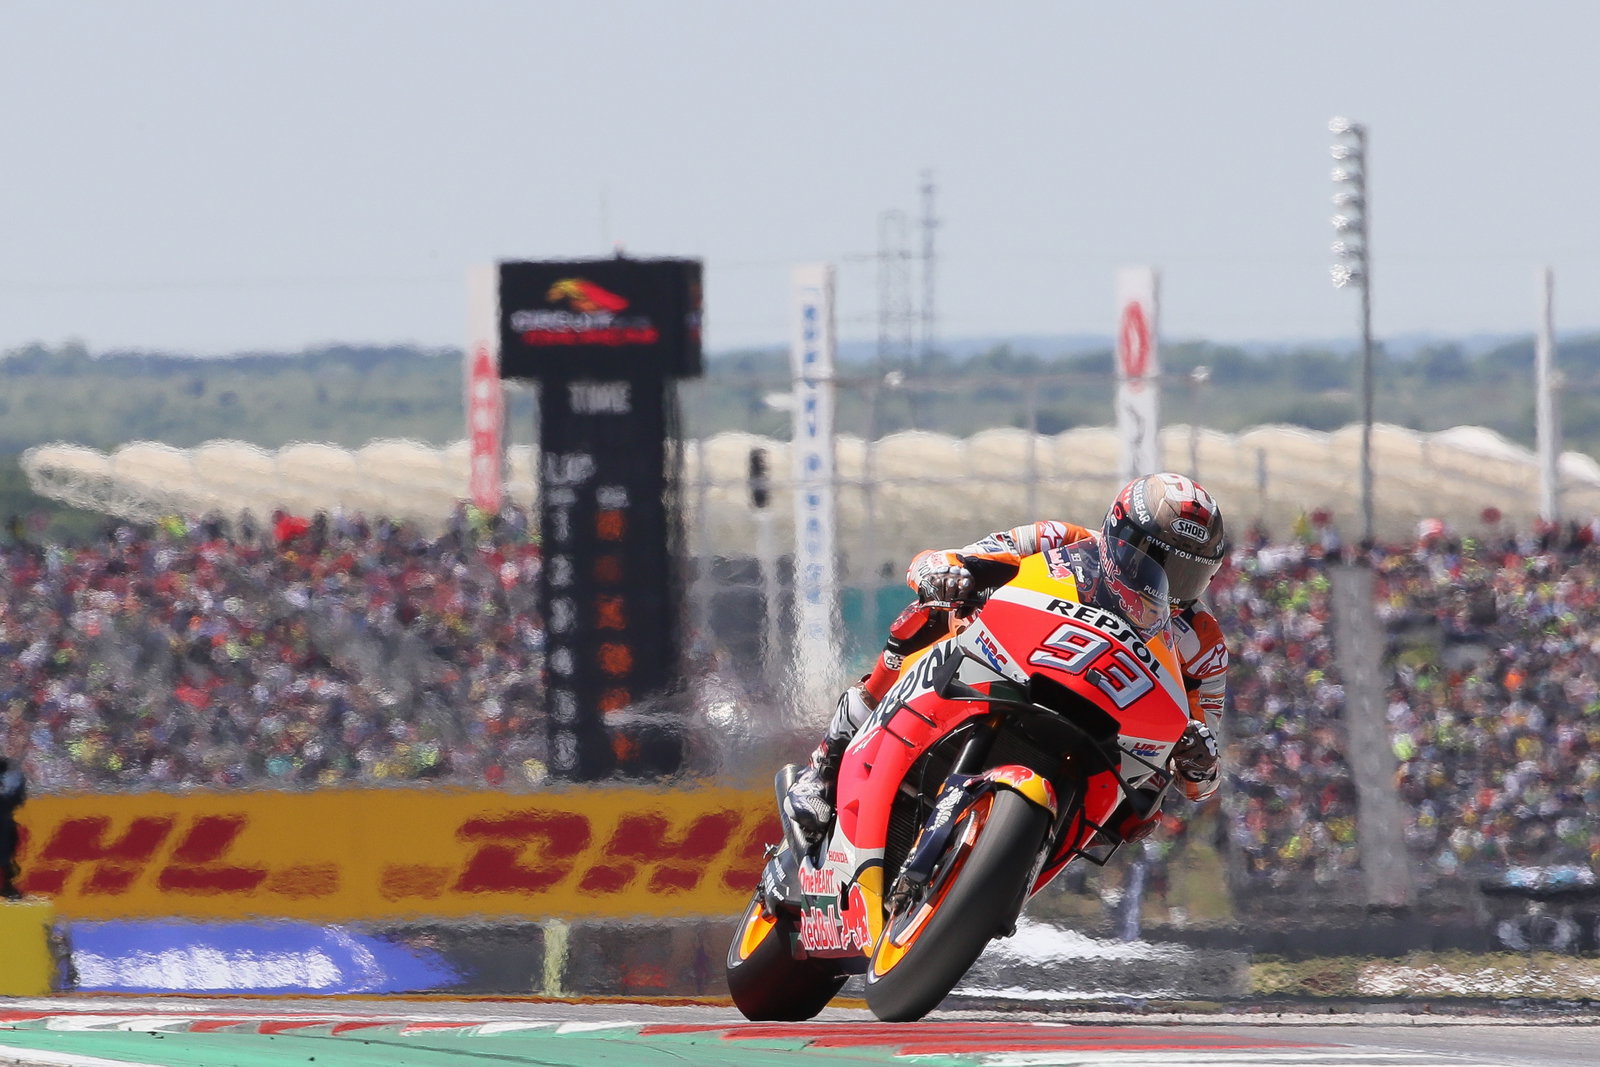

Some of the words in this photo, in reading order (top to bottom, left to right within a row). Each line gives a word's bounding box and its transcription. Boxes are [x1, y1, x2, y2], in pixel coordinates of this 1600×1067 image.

[1177, 521, 1206, 540] SHOEI
[1146, 535, 1170, 552] GIVES
[1174, 548, 1192, 560] YOU
[1194, 555, 1216, 566] WINGS
[1144, 585, 1181, 605] PULL&BEAR
[1046, 598, 1162, 679] REPSOL
[1027, 622, 1155, 710] 93
[17, 815, 268, 893] HL
[828, 850, 849, 864] HONDA
[815, 904, 842, 950] Bull
